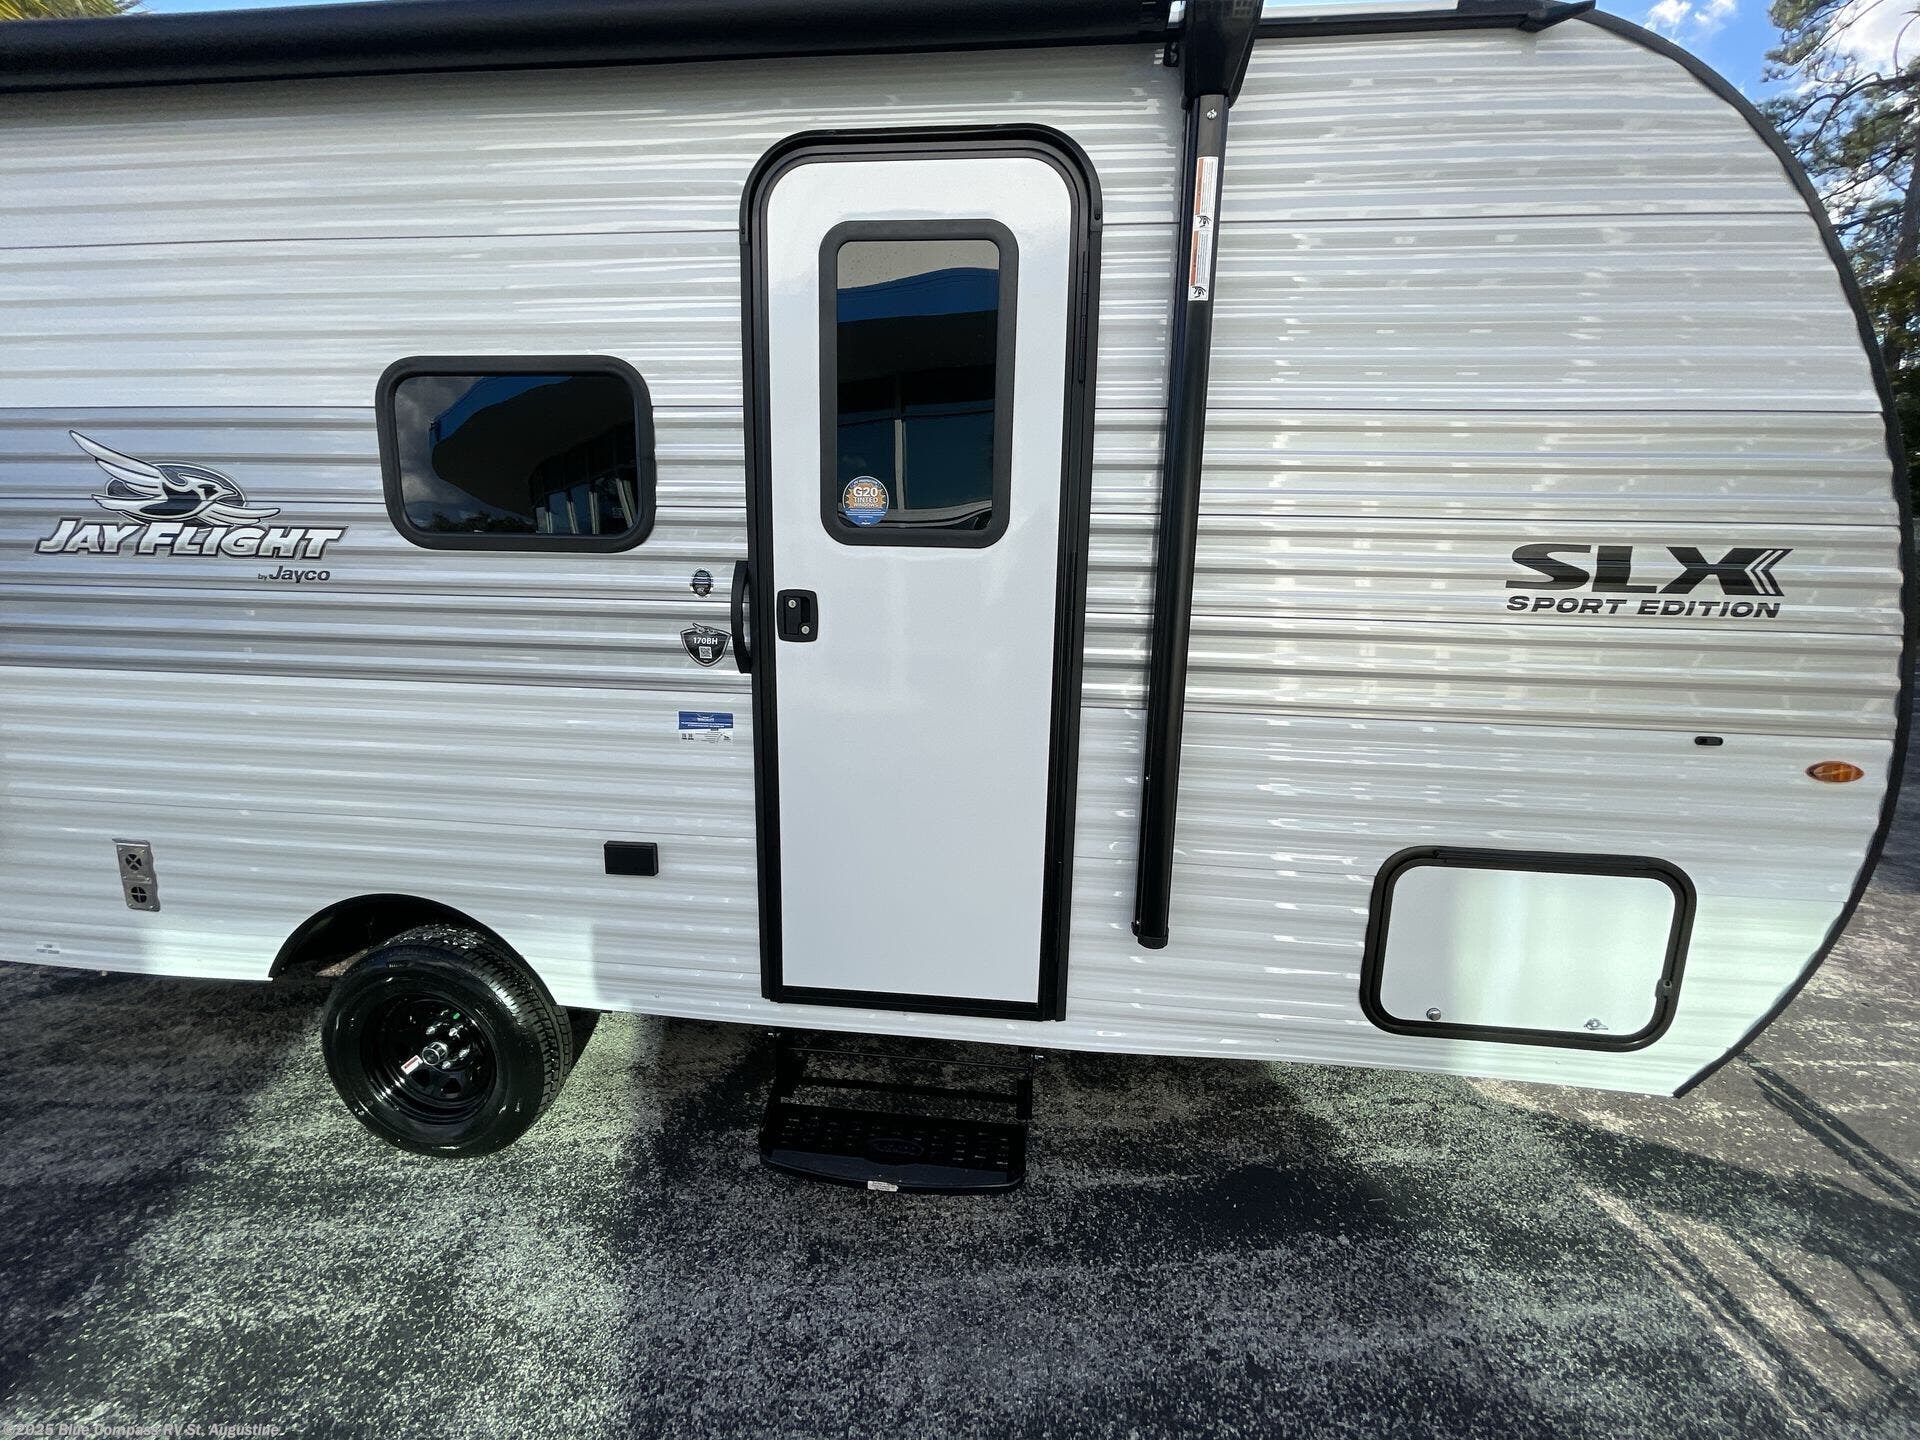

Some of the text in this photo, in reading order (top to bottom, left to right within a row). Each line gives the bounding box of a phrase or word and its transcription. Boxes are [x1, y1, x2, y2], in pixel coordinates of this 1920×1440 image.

[853, 486, 878, 497] G20
[35, 517, 349, 560] JAY FLIGHT
[258, 565, 331, 584] by Jayco
[1505, 543, 1794, 597] SLX
[1506, 595, 1782, 619] SPORT EDITION
[693, 636, 719, 645] 170BH
